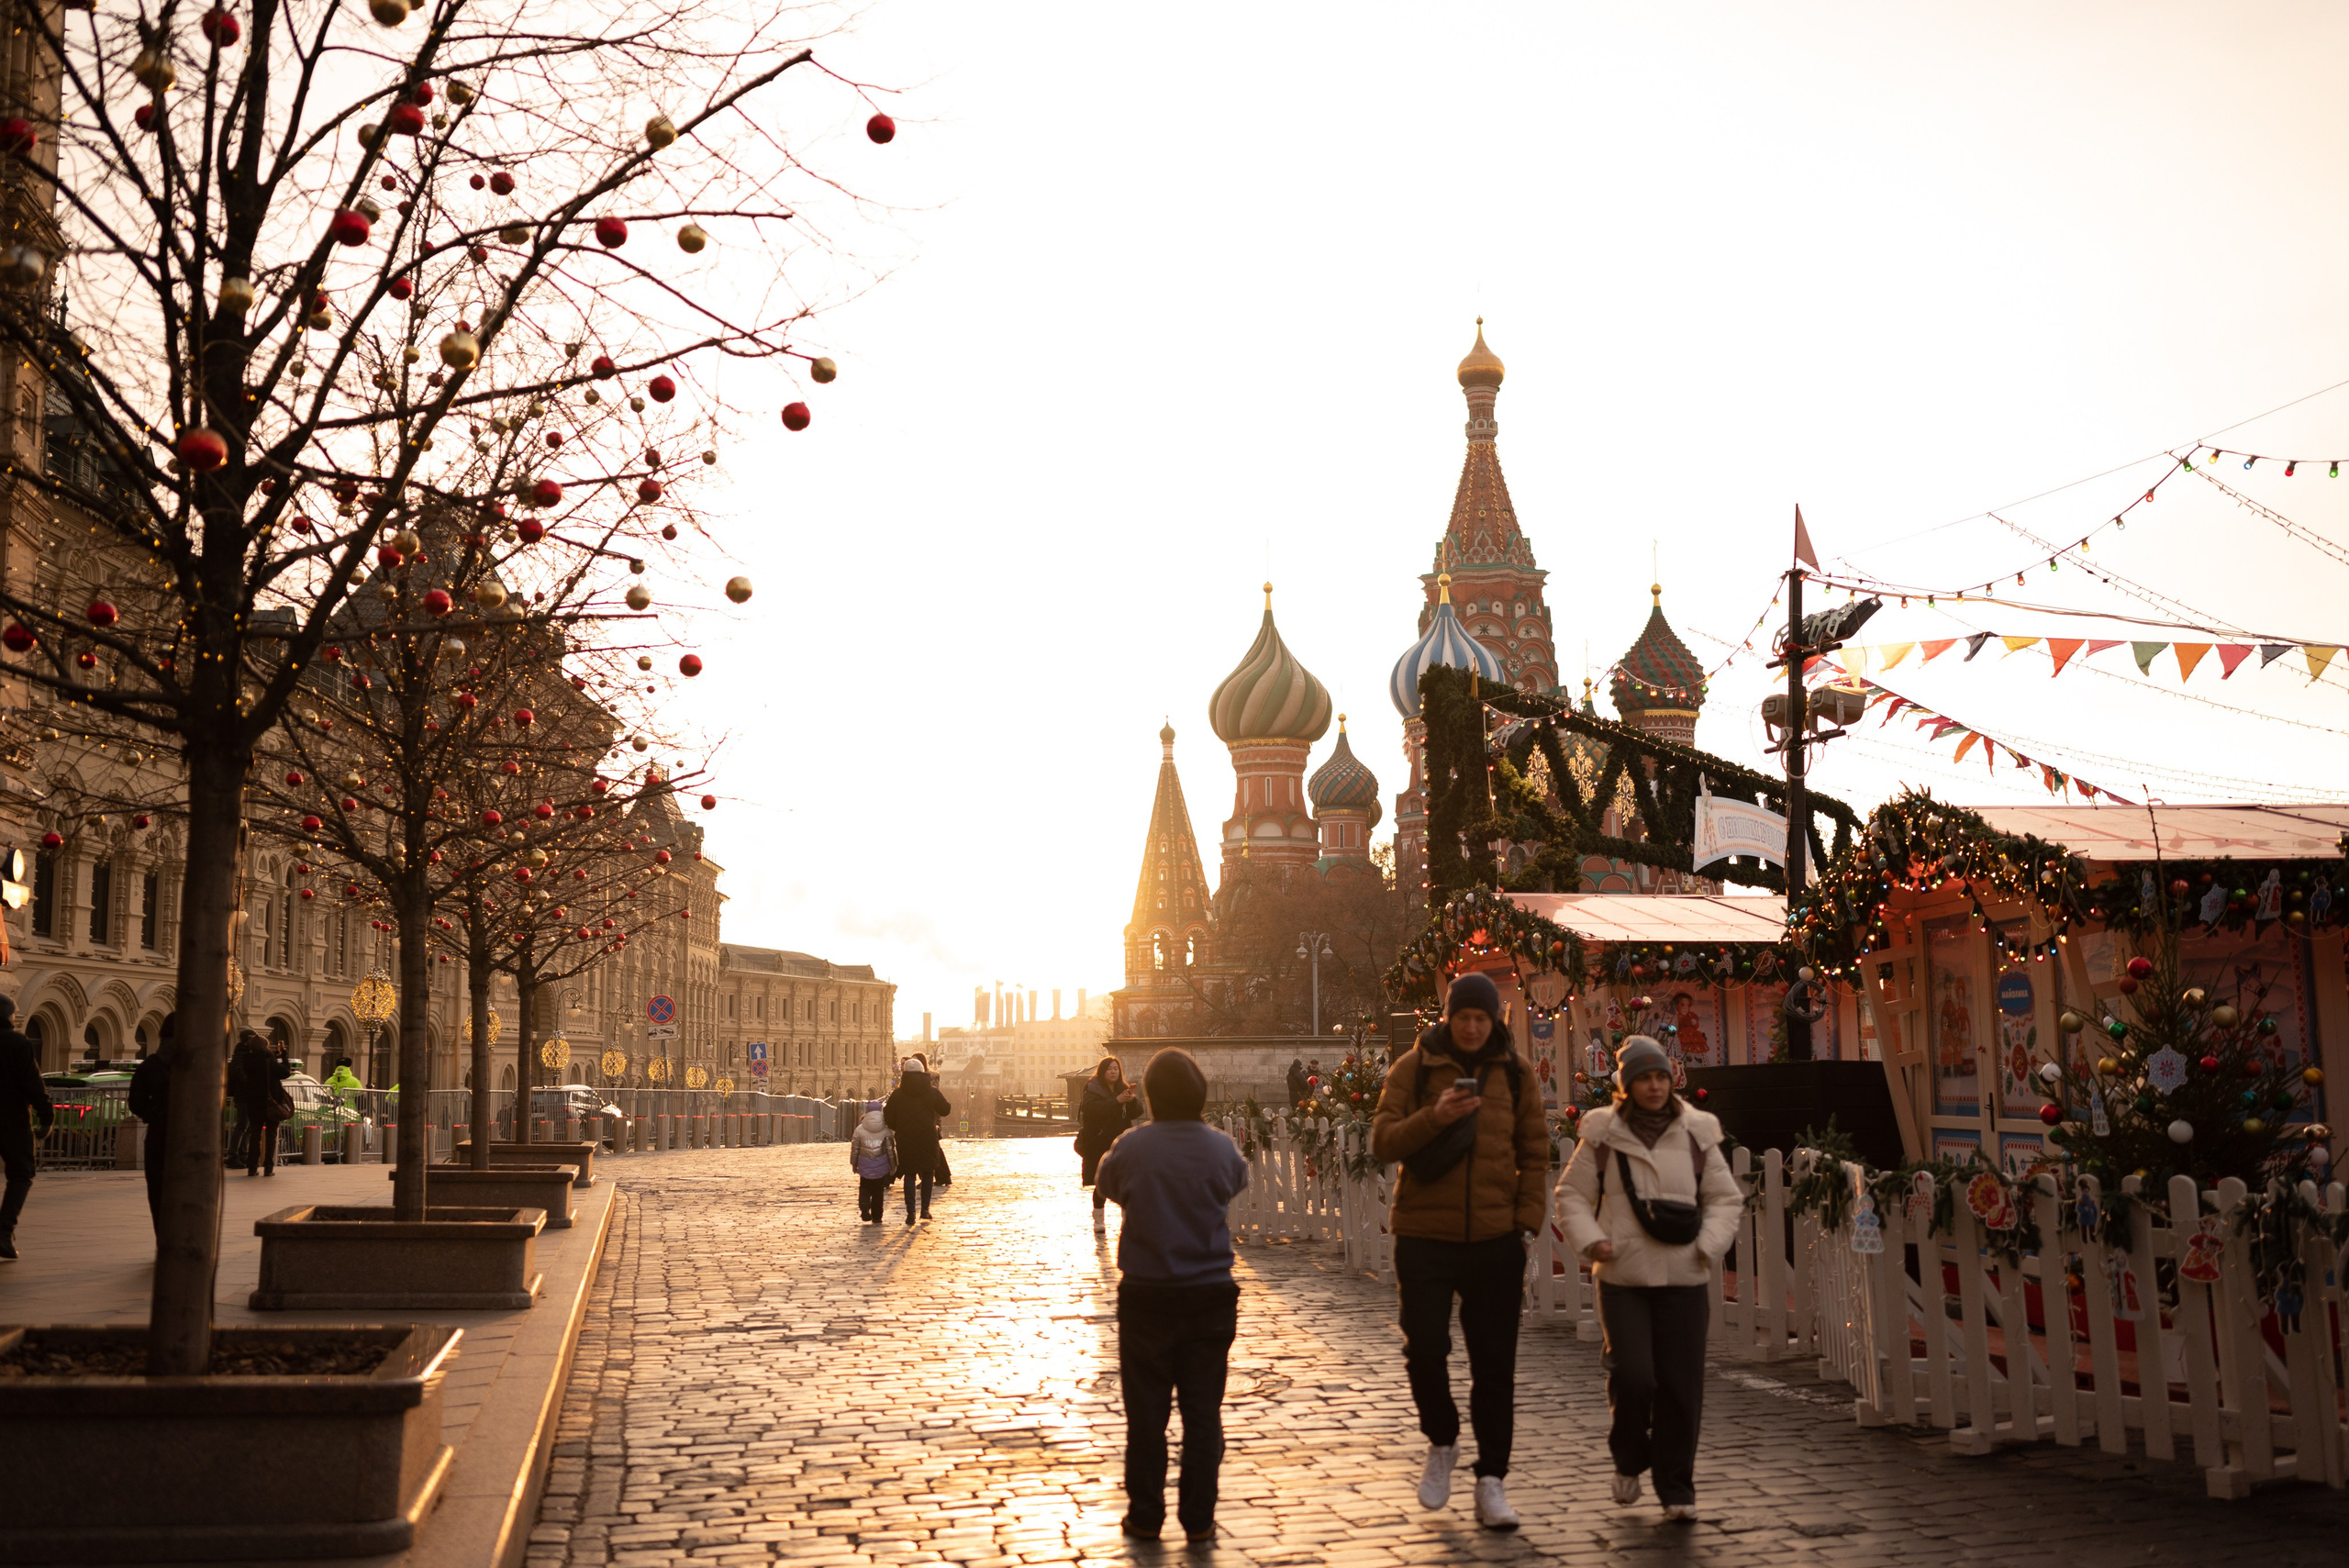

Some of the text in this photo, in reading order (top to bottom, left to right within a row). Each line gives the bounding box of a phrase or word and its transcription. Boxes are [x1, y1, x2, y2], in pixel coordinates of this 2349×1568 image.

[1718, 817, 1726, 840] С
[1725, 816, 1760, 841] НОВЫМ
[2001, 987, 2029, 999] МАЙОЛИКА
